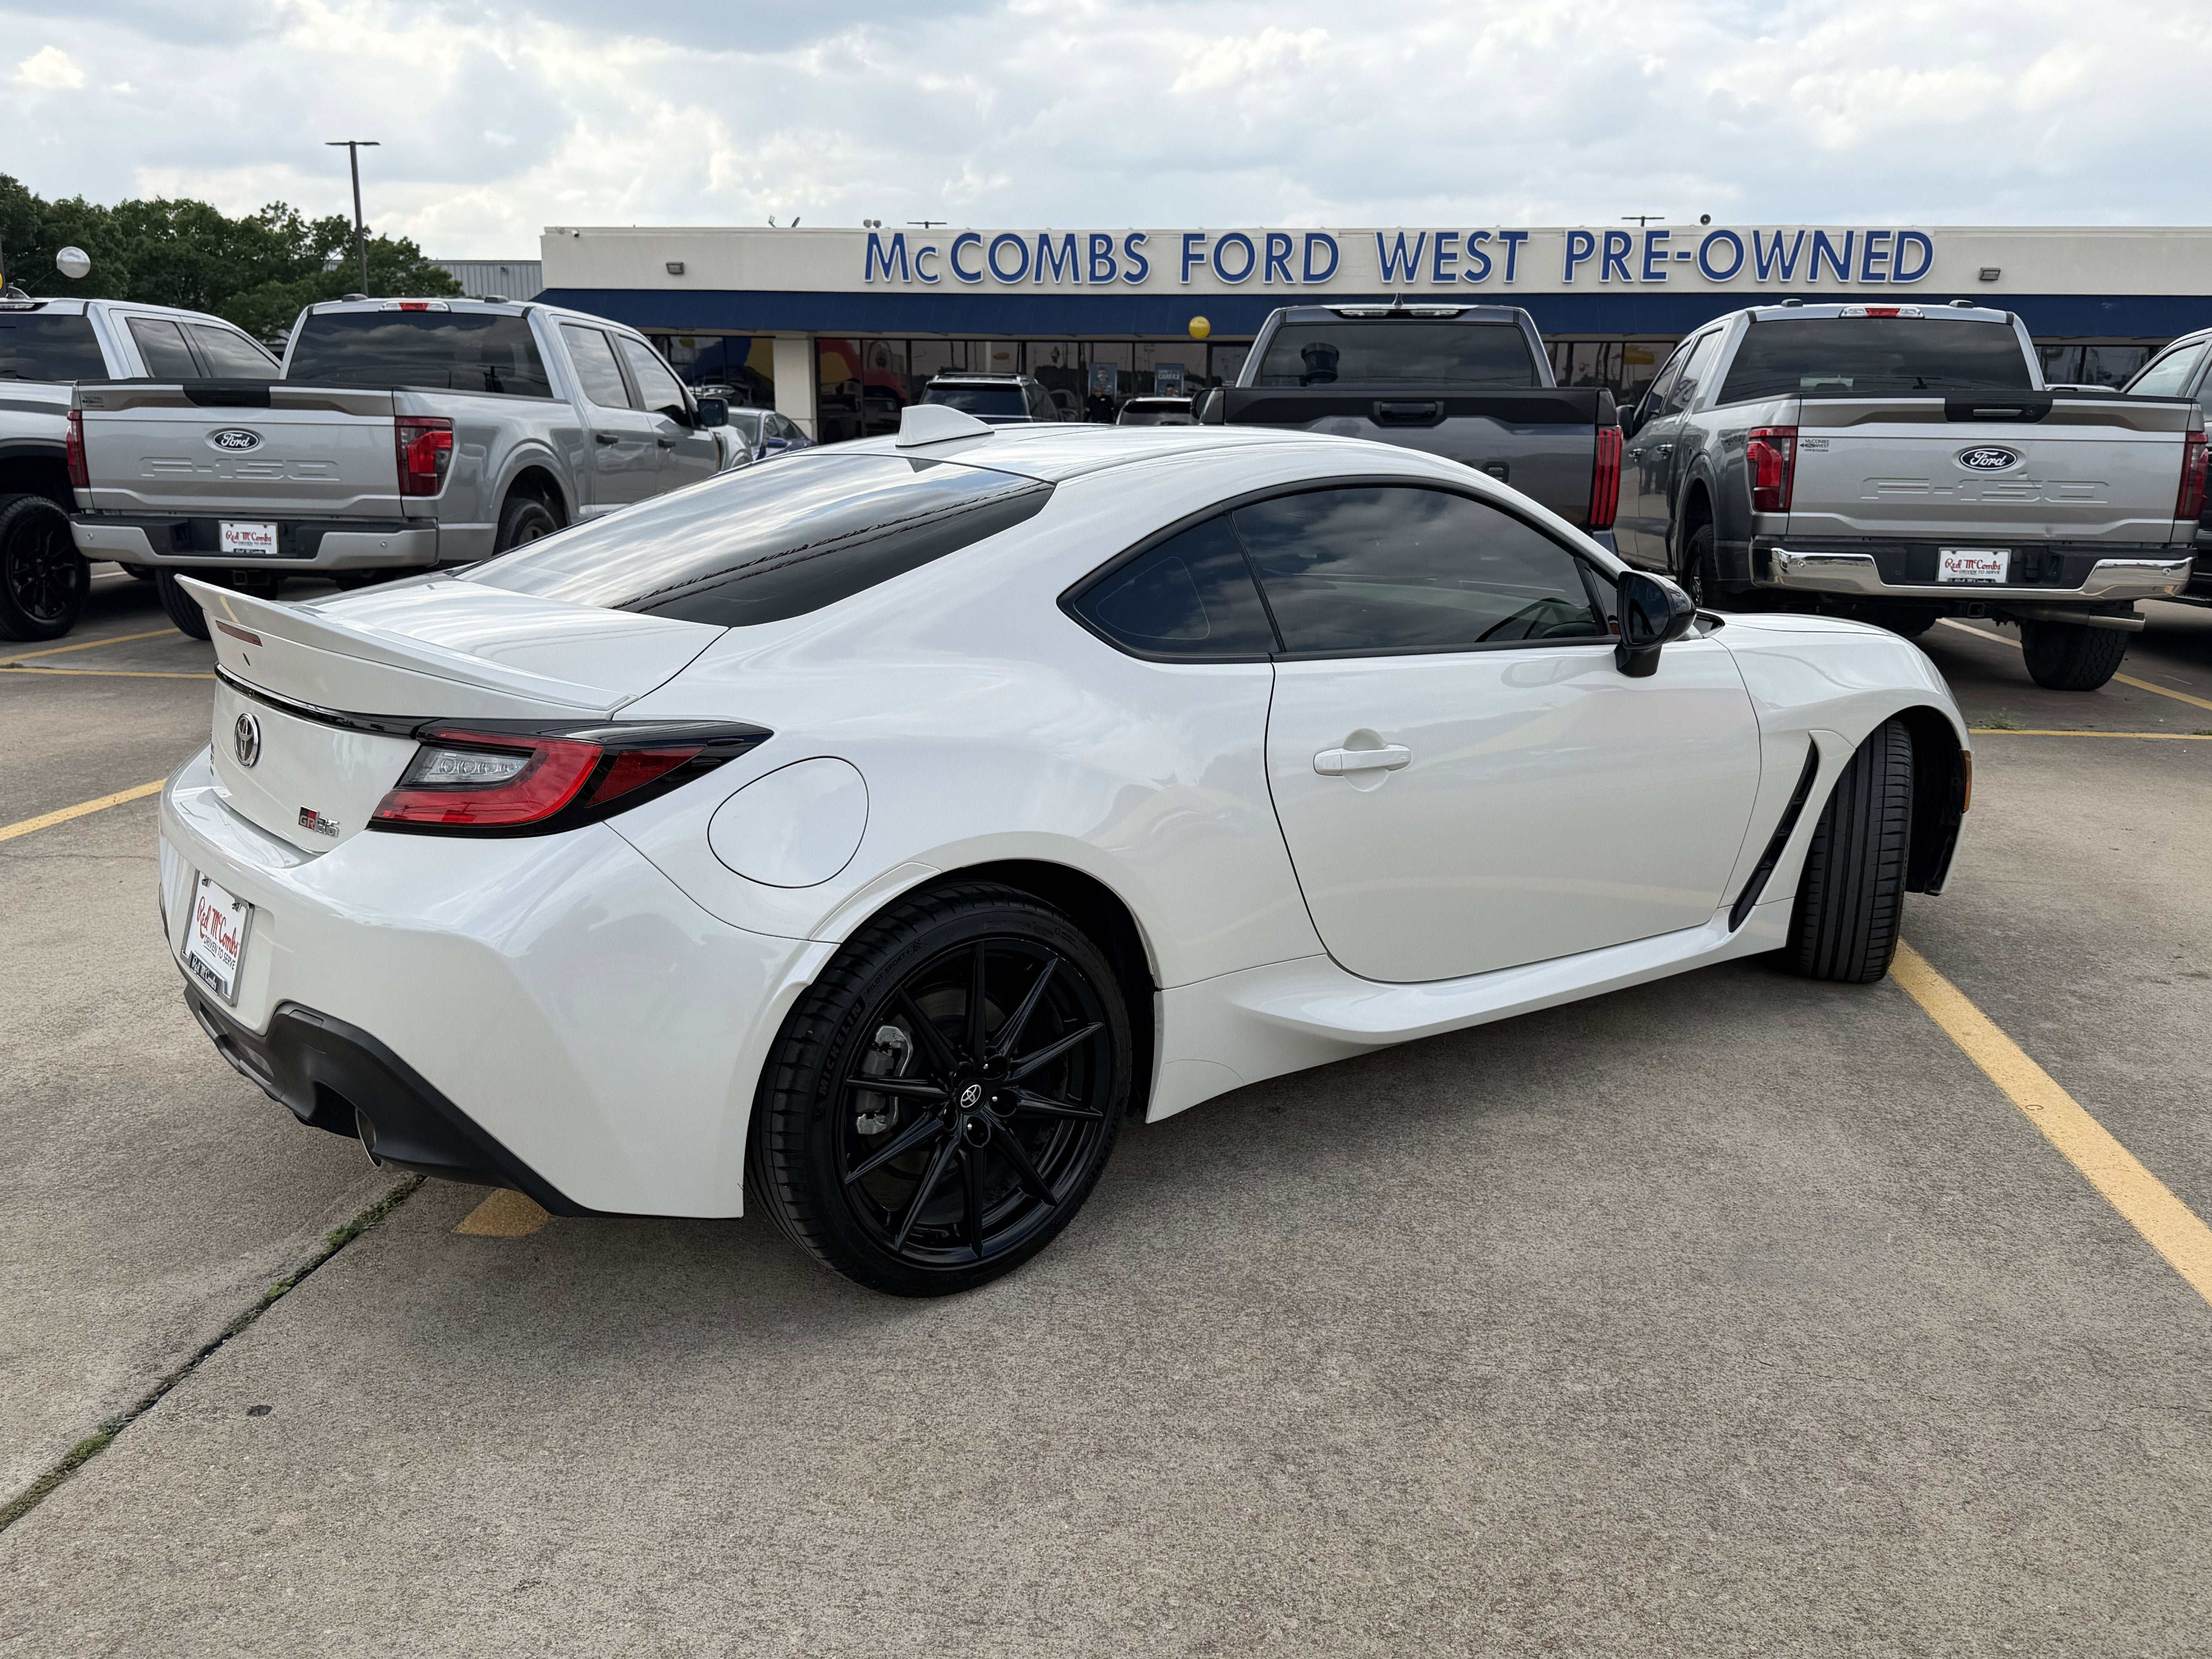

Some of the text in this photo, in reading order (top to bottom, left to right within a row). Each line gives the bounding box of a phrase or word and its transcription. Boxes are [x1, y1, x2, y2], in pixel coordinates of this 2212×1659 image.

[864, 229, 1934, 283] McCOMBS FORD WEST PRE-OWNED
[220, 432, 251, 448] Ford
[140, 457, 340, 481] F-150
[1969, 450, 2006, 466] Ford
[1861, 477, 2110, 503] F-150
[225, 530, 240, 544] Red
[1945, 558, 2001, 573] Red McCombs
[196, 896, 239, 958] Red McCombs
[203, 934, 236, 970] DRIVEN TO SERVE
[866, 972, 883, 994] PILOT
[884, 953, 905, 974] SPORT
[818, 1002, 862, 1096] MICHELIN
